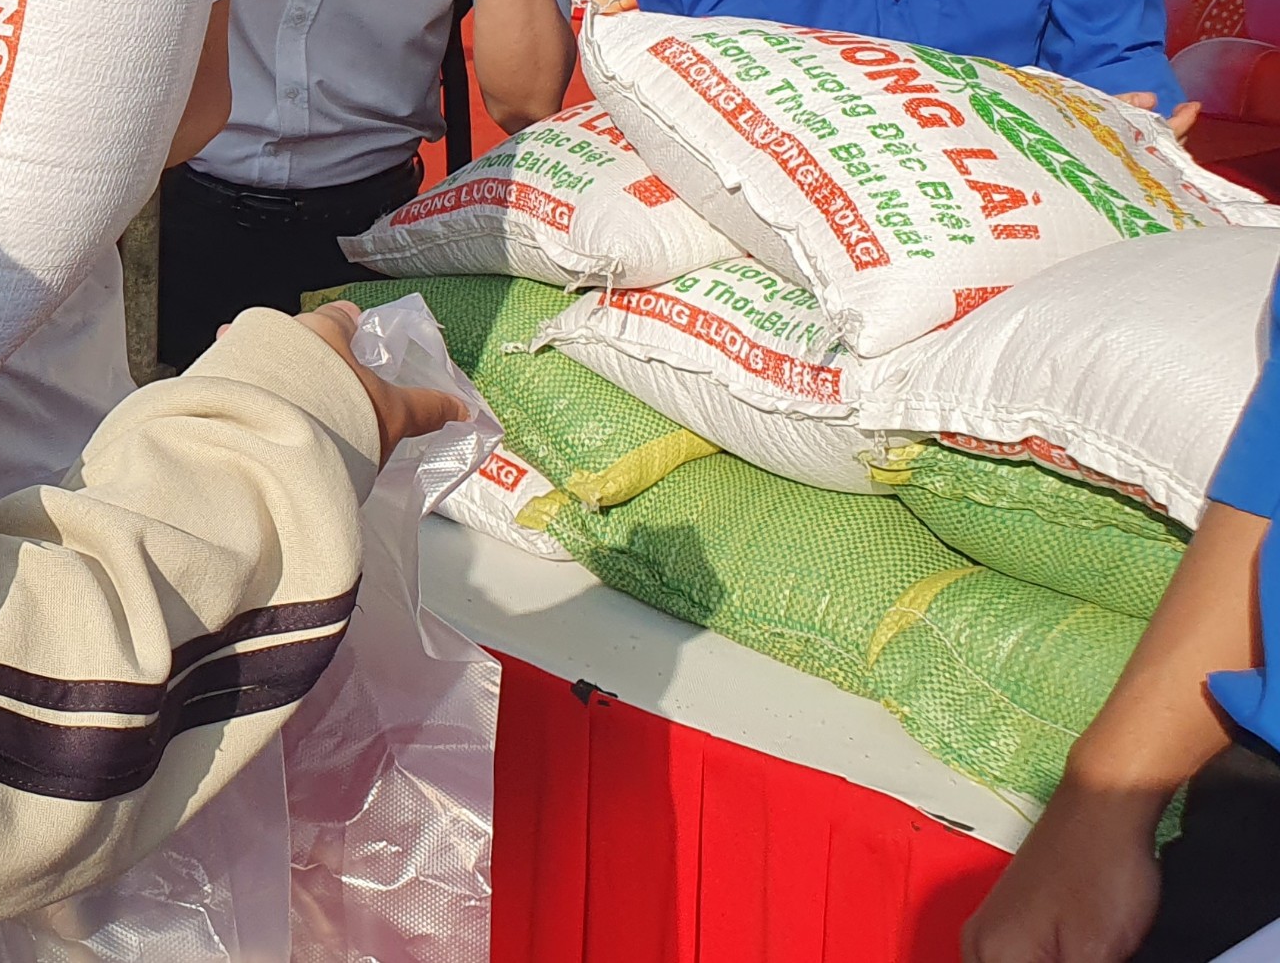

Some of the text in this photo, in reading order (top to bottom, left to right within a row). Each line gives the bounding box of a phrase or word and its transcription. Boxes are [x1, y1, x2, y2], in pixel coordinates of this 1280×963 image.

[514, 151, 550, 174] Bát
[460, 179, 518, 205] LƯỢNG
[941, 146, 1042, 241] LÀI
